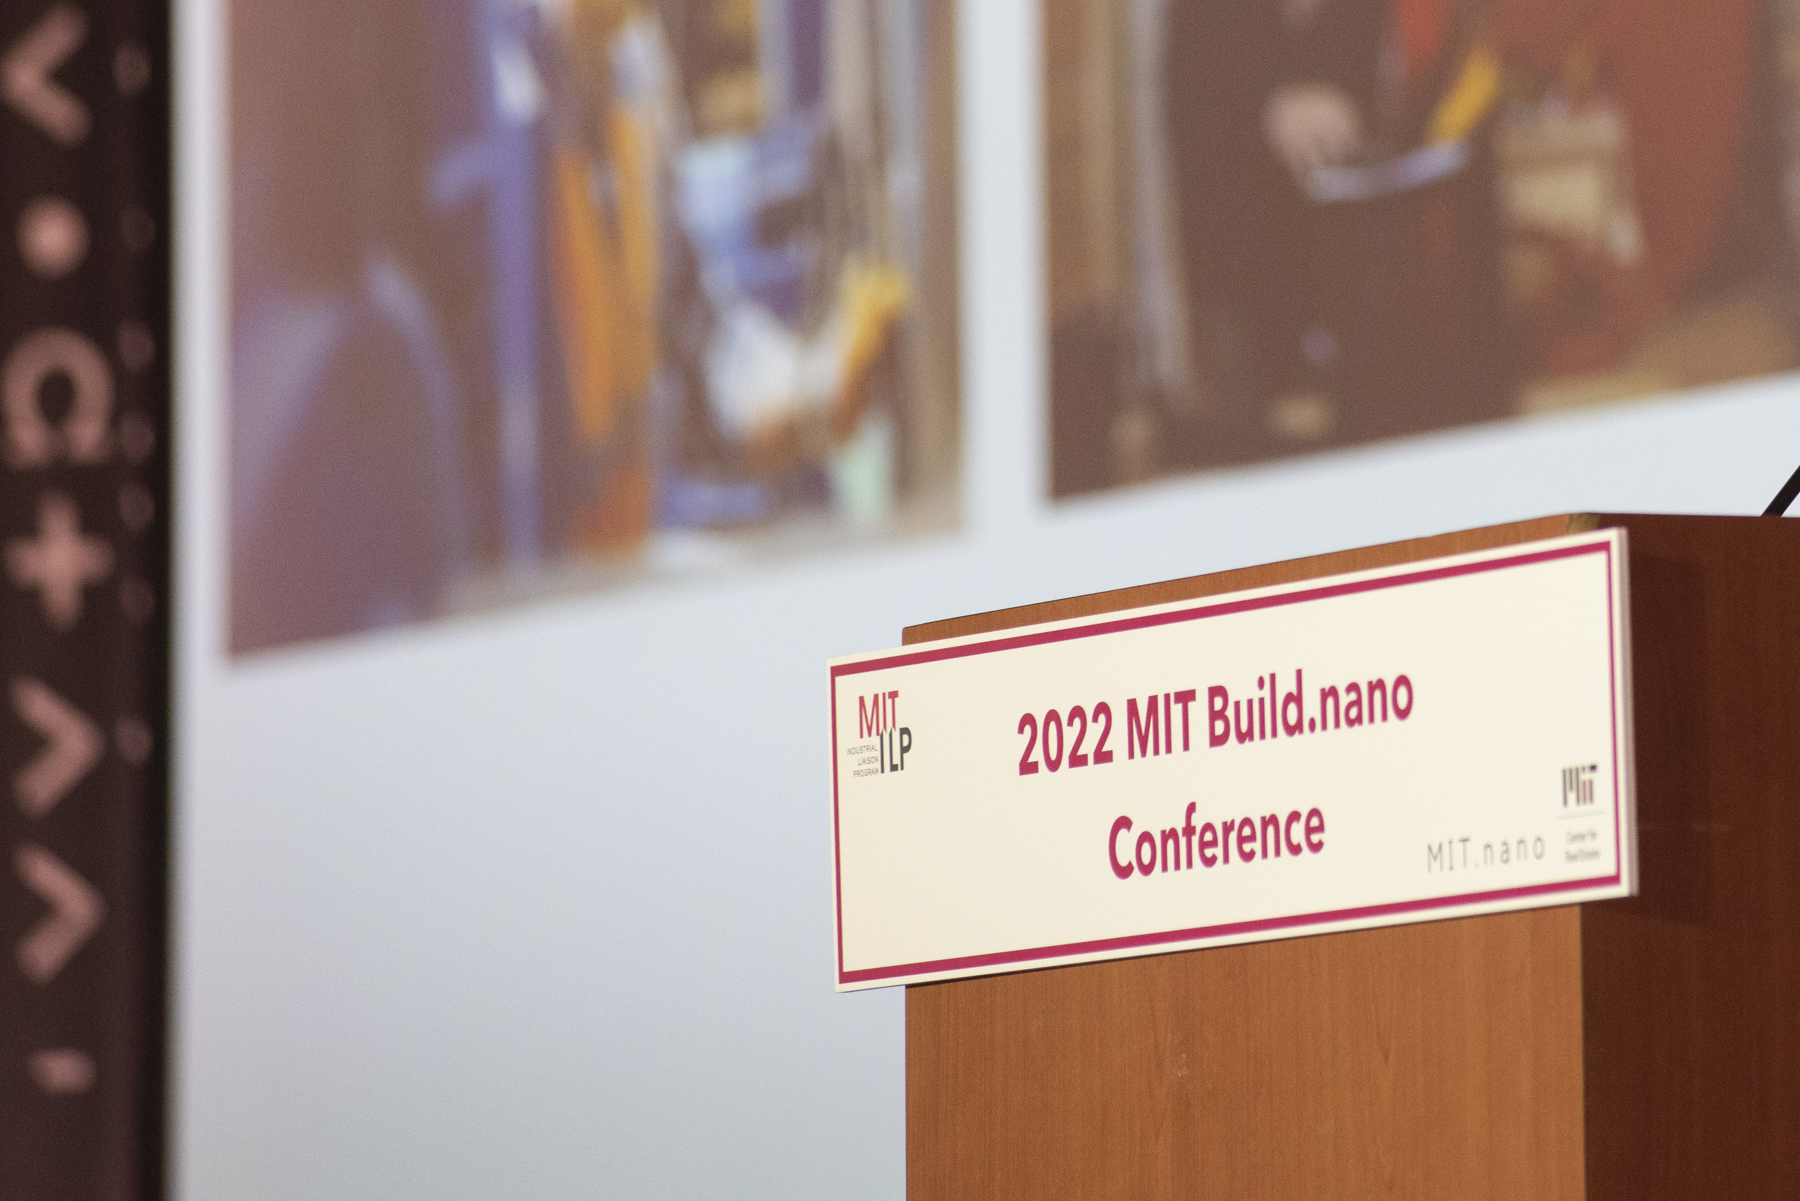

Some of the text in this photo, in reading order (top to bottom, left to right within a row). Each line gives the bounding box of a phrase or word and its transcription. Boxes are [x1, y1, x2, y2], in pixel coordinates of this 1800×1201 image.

[858, 690, 900, 739] MIT
[1017, 668, 1414, 776] 2022 MIT Build.nano
[846, 744, 879, 756] INDUSTRIAL
[857, 755, 880, 767] LIAISON
[852, 767, 880, 779] PROGRAM
[1108, 801, 1326, 880] Conference
[1426, 834, 1546, 874] MIT.nano
